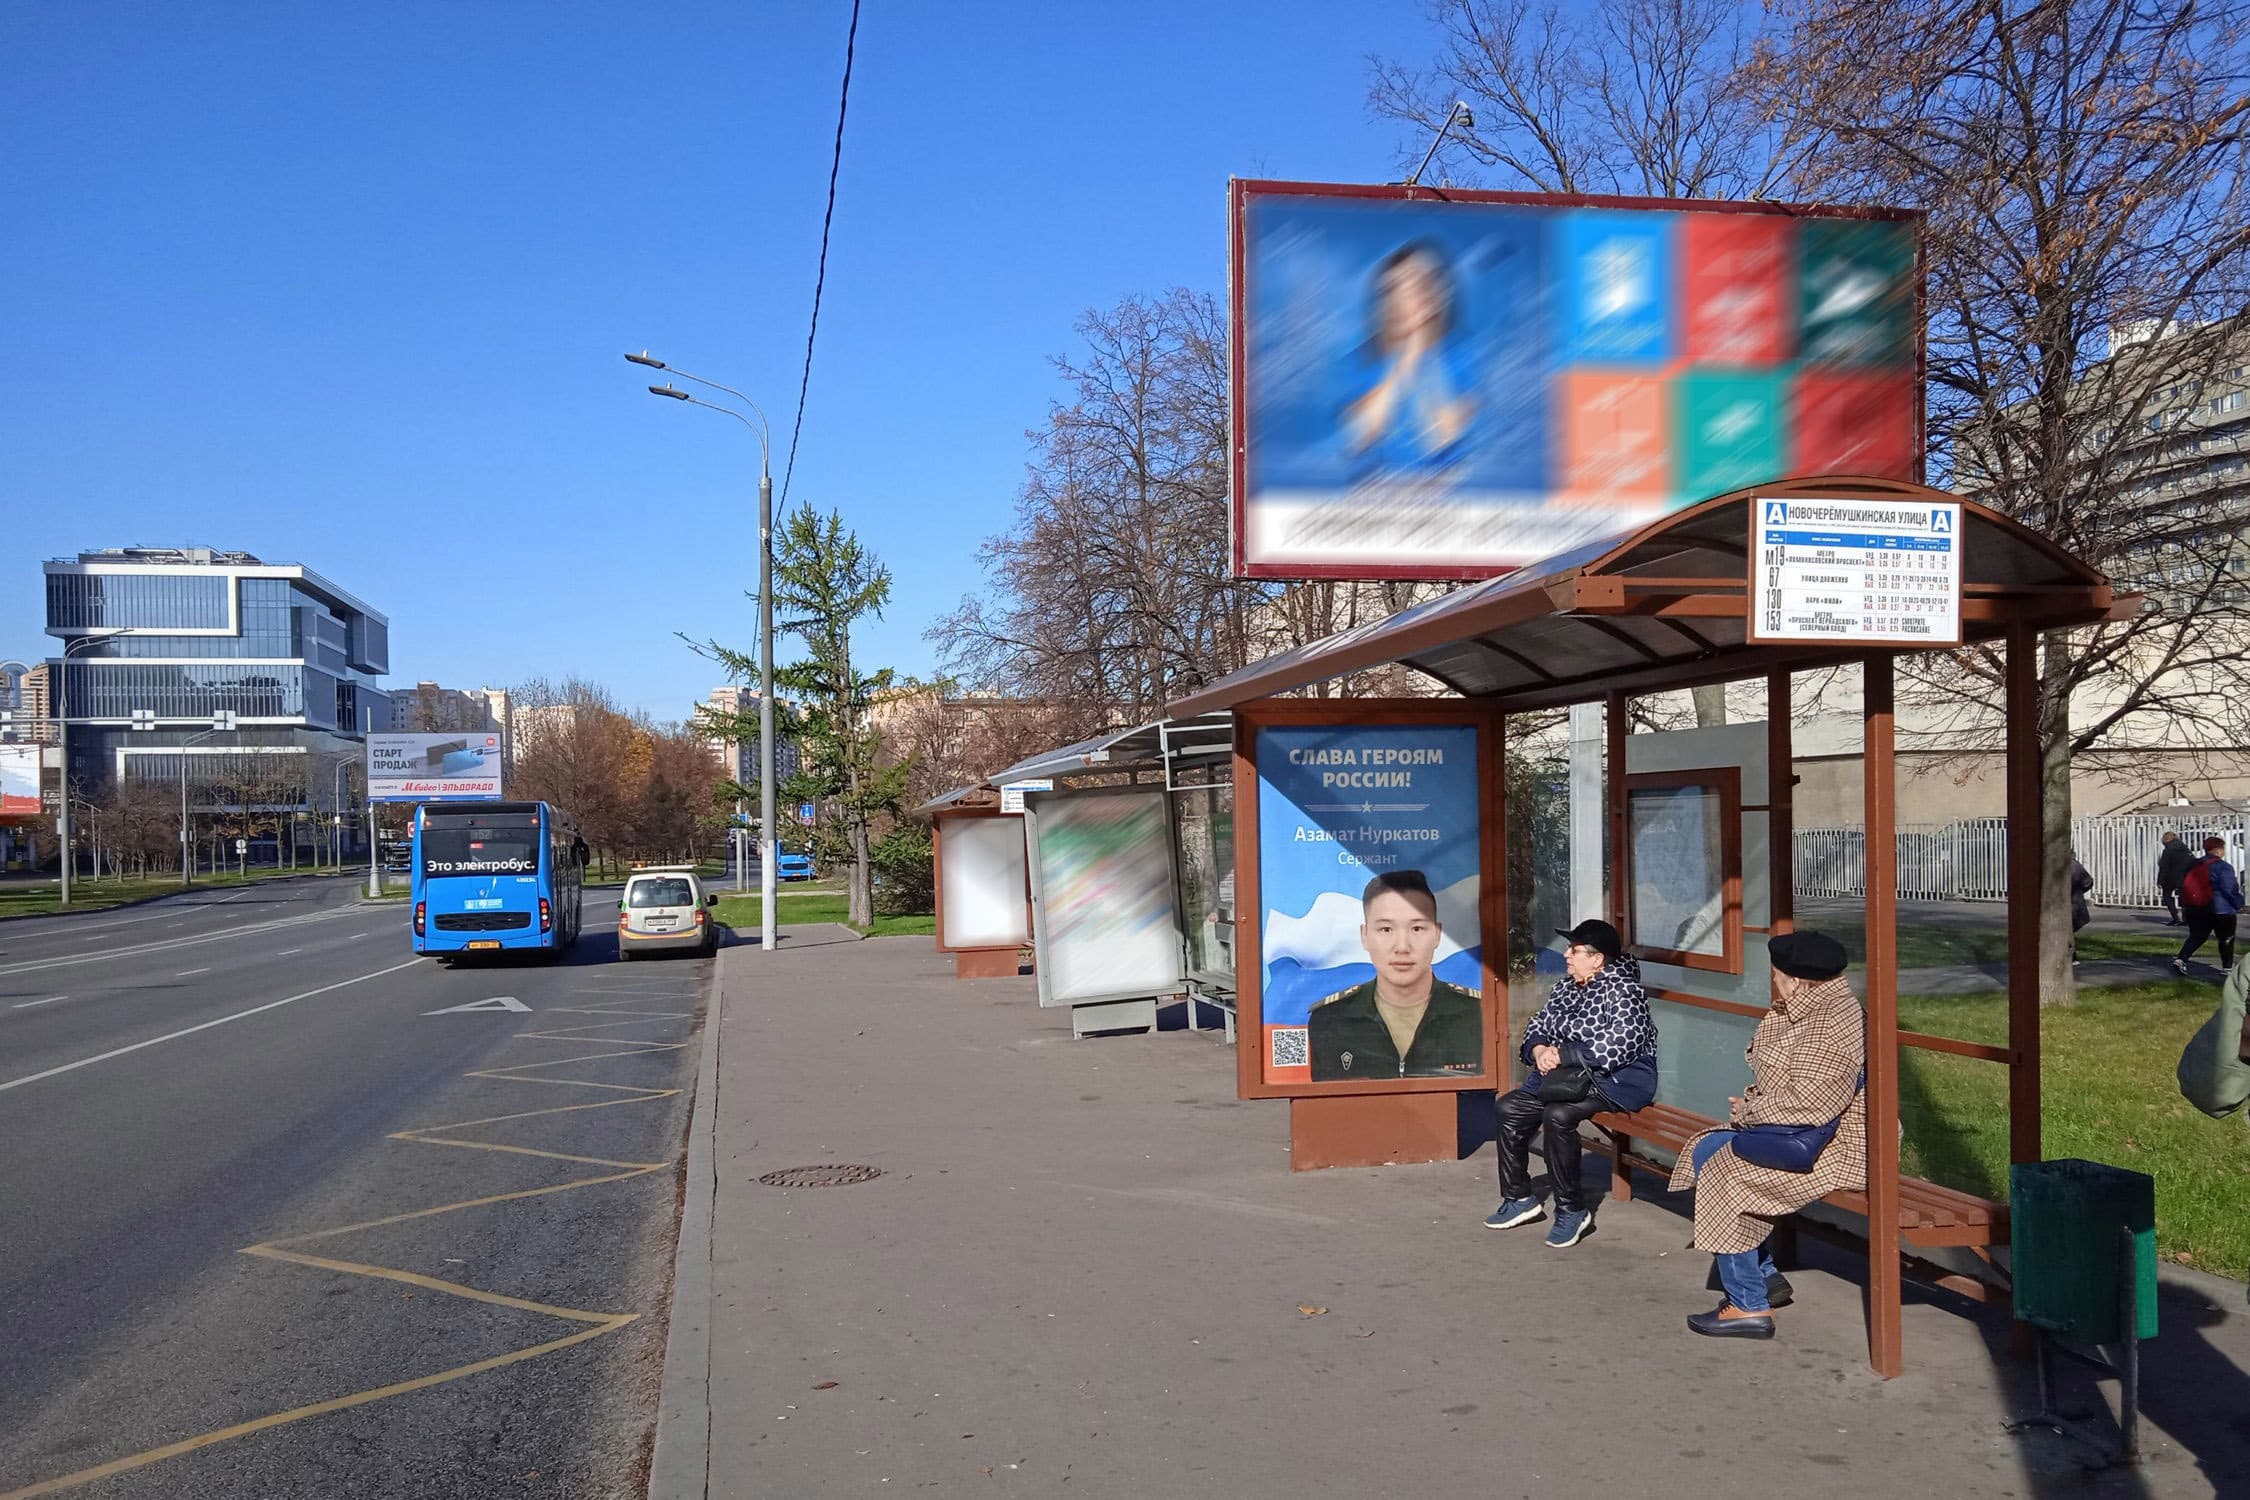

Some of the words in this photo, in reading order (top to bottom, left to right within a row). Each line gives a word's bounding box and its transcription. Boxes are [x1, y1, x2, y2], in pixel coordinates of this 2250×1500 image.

[1788, 505, 1896, 524] НОВОЧЕРЁМУШКИНСКАЯ
[1898, 511, 1928, 526] УЛИЦА
[1765, 545, 1785, 566] М19
[1769, 566, 1780, 588] 67
[1766, 588, 1782, 610] 130
[1766, 610, 1781, 632] 153
[373, 748, 403, 758] СТАРТ
[1289, 748, 1356, 766] СЛАВА
[1362, 748, 1443, 766] ГЕРОЯМ
[373, 760, 417, 770] ПРОДАЖ
[441, 783, 494, 792] ЭЛЬДОРАДО
[1323, 771, 1411, 788] РОССИИ!
[1294, 826, 1356, 842] Азамат
[1359, 826, 1440, 845] Нуркатов
[427, 860, 452, 872] Это
[455, 857, 535, 873] электробус.
[1338, 851, 1397, 867] Сержант
